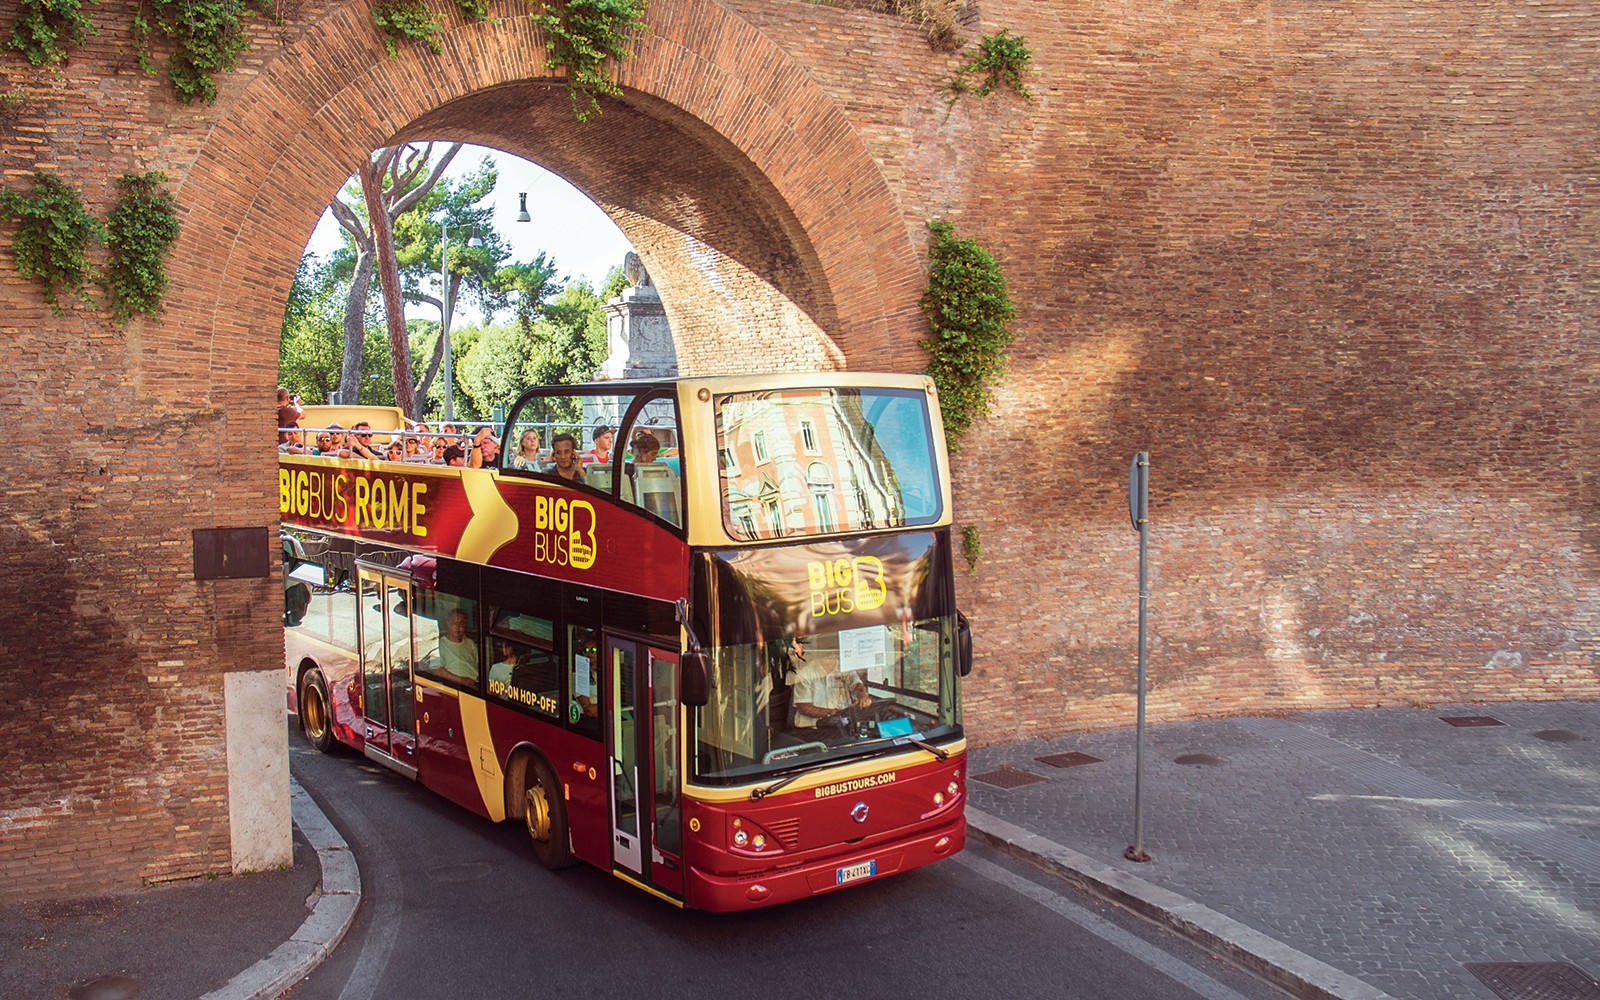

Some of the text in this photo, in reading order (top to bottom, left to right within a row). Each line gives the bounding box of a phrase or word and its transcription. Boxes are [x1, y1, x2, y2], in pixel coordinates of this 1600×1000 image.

[355, 476, 428, 537] ROME
[535, 495, 568, 532] BIG
[535, 531, 568, 566] BUS
[807, 558, 852, 590] BIG
[811, 587, 854, 617] BUS
[489, 680, 557, 714] HOP-ON HOP-OFF
[815, 772, 896, 798] BIGBUSTOURS.COM
